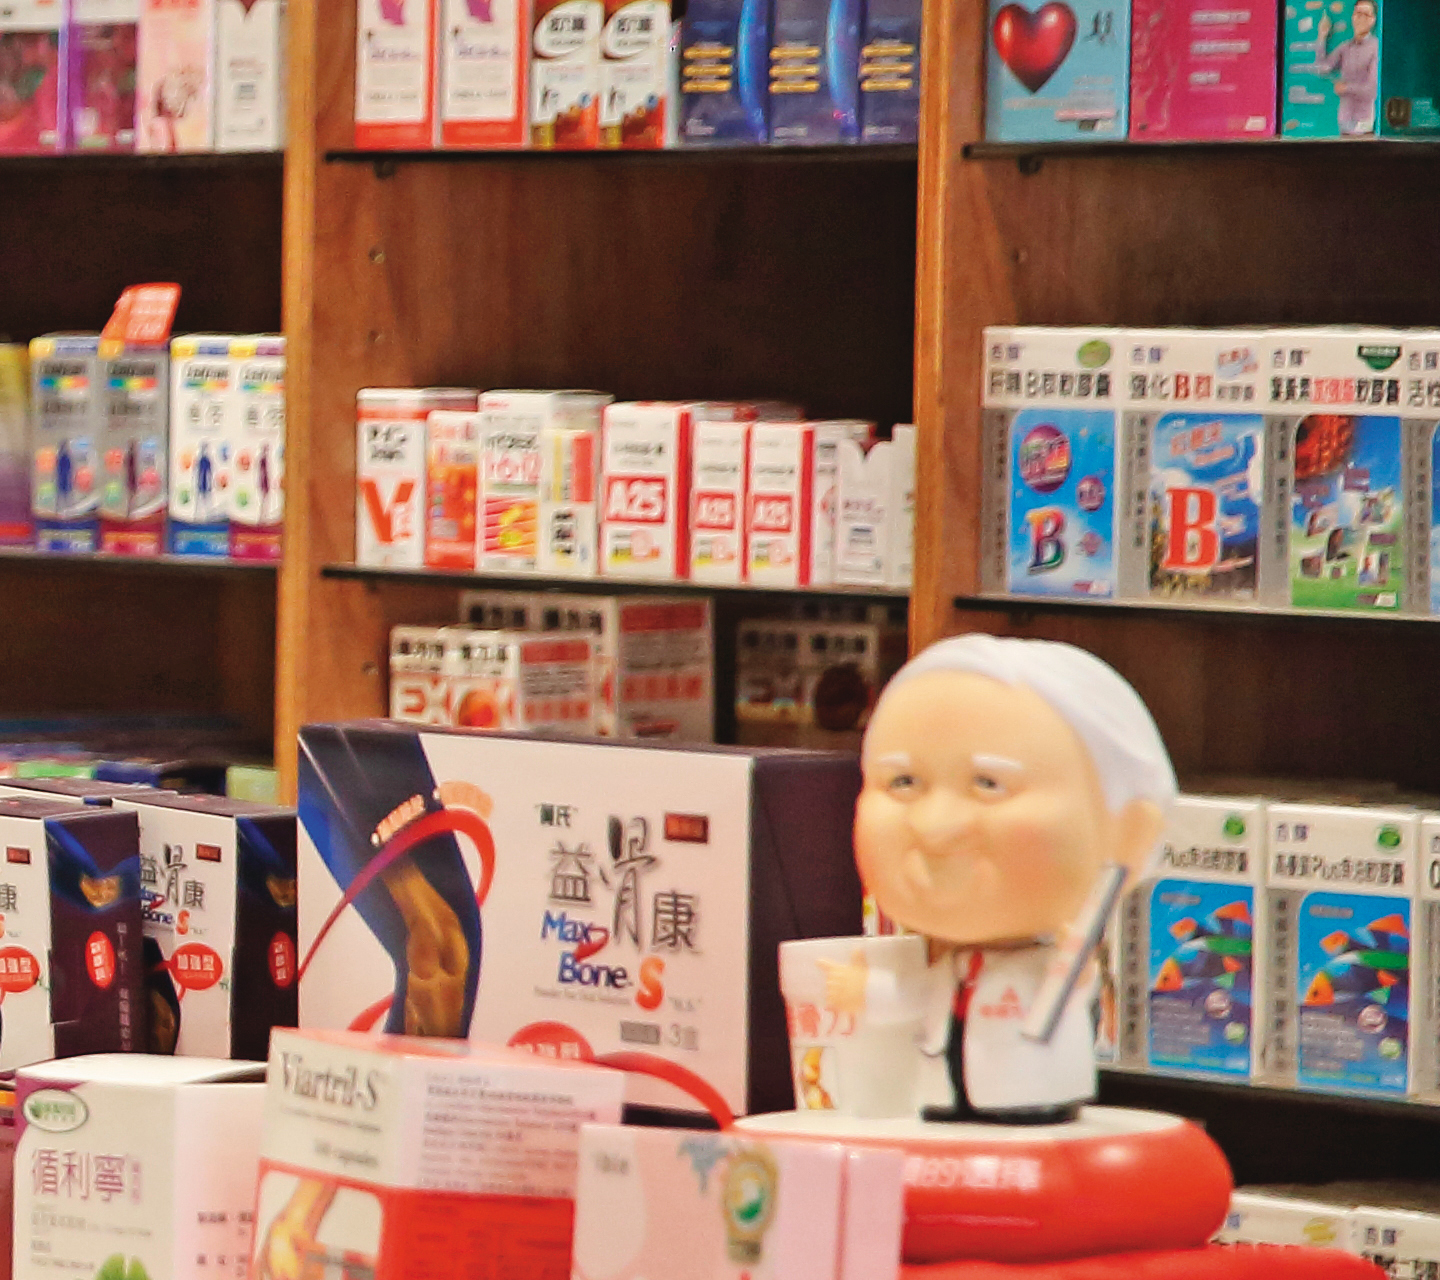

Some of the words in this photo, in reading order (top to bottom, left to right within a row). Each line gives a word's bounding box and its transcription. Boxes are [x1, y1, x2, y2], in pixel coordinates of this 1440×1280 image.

[608, 480, 665, 520] A25
[1165, 486, 1217, 569] B
[548, 814, 698, 952] 益骨康
[542, 909, 591, 942] Max
[558, 951, 628, 989] Bone
[635, 956, 666, 1011] S
[280, 1052, 379, 1111] Viartril-S
